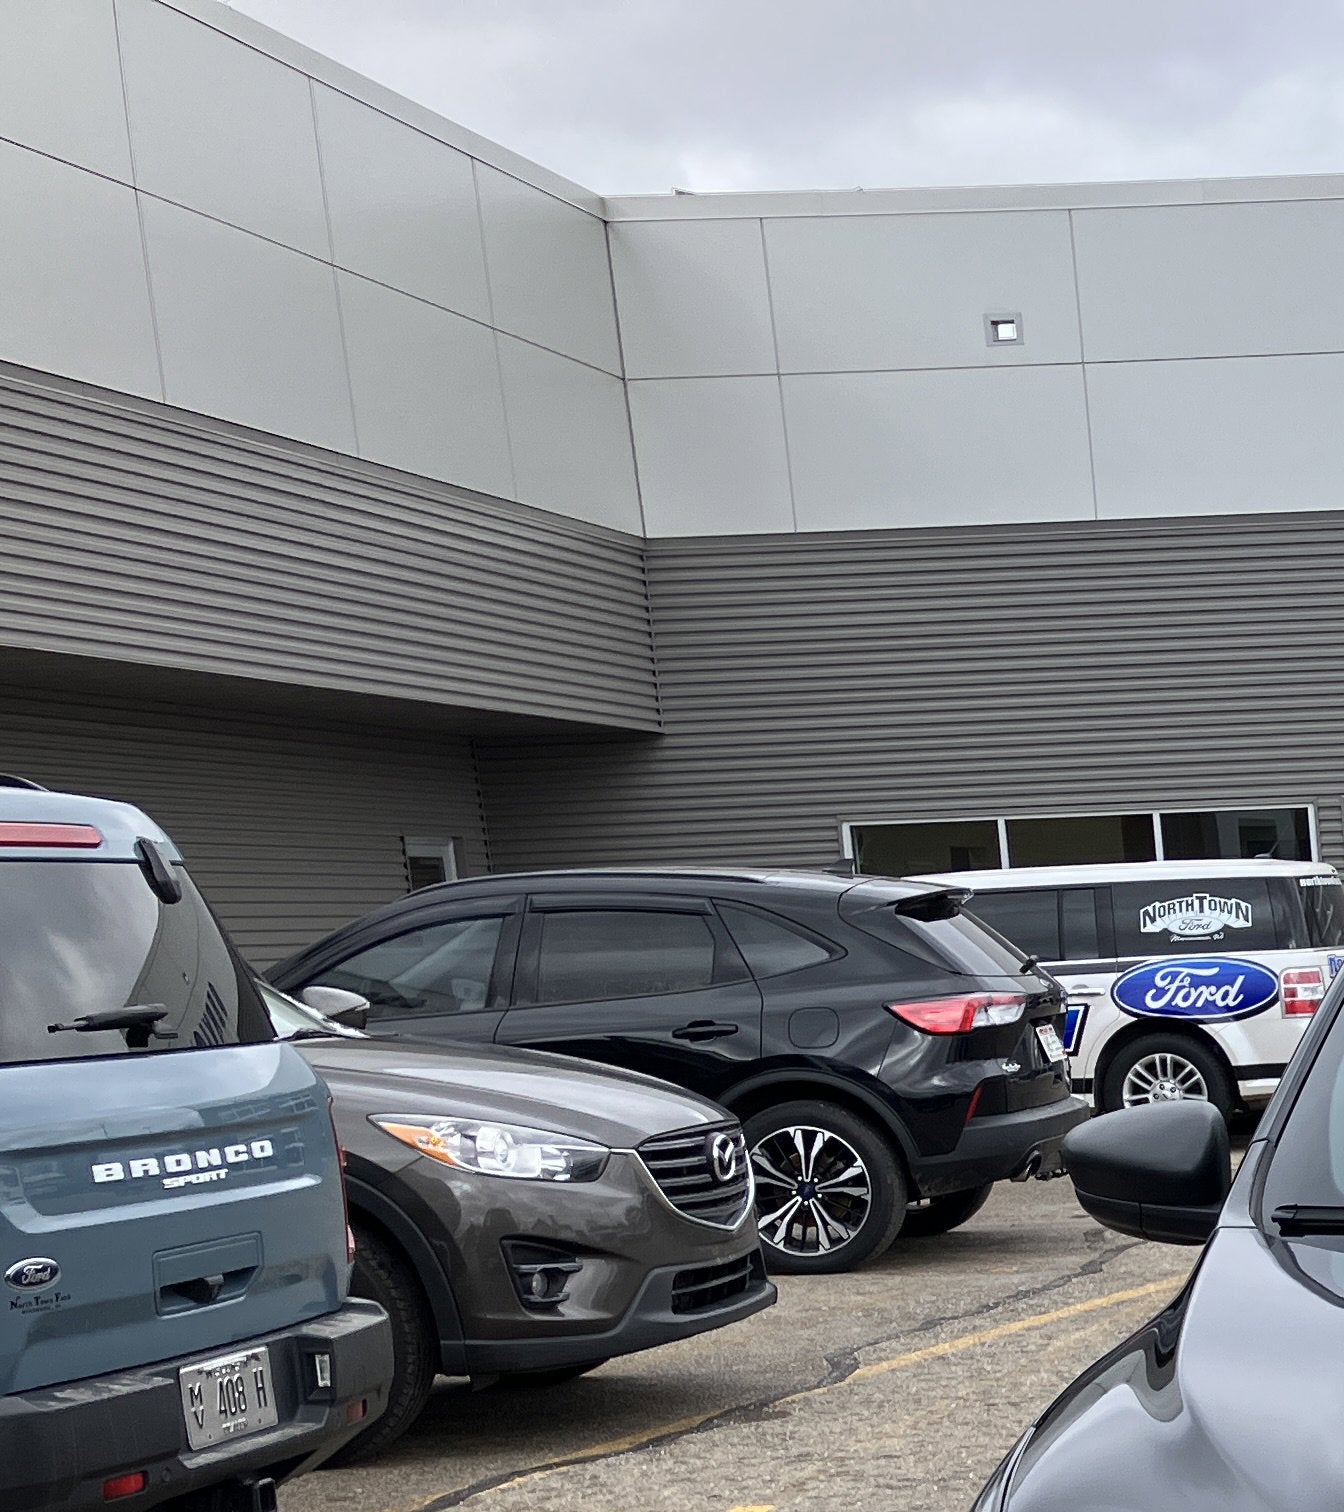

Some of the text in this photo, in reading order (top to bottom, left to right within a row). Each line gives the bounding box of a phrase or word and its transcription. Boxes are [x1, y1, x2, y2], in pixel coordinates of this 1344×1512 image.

[1179, 918, 1212, 931] Ford
[1145, 967, 1245, 1009] Ford
[91, 1140, 273, 1183] BRONCO
[162, 1168, 229, 1189] SPORT
[22, 1264, 51, 1284] Ford
[217, 1373, 247, 1418] 408
